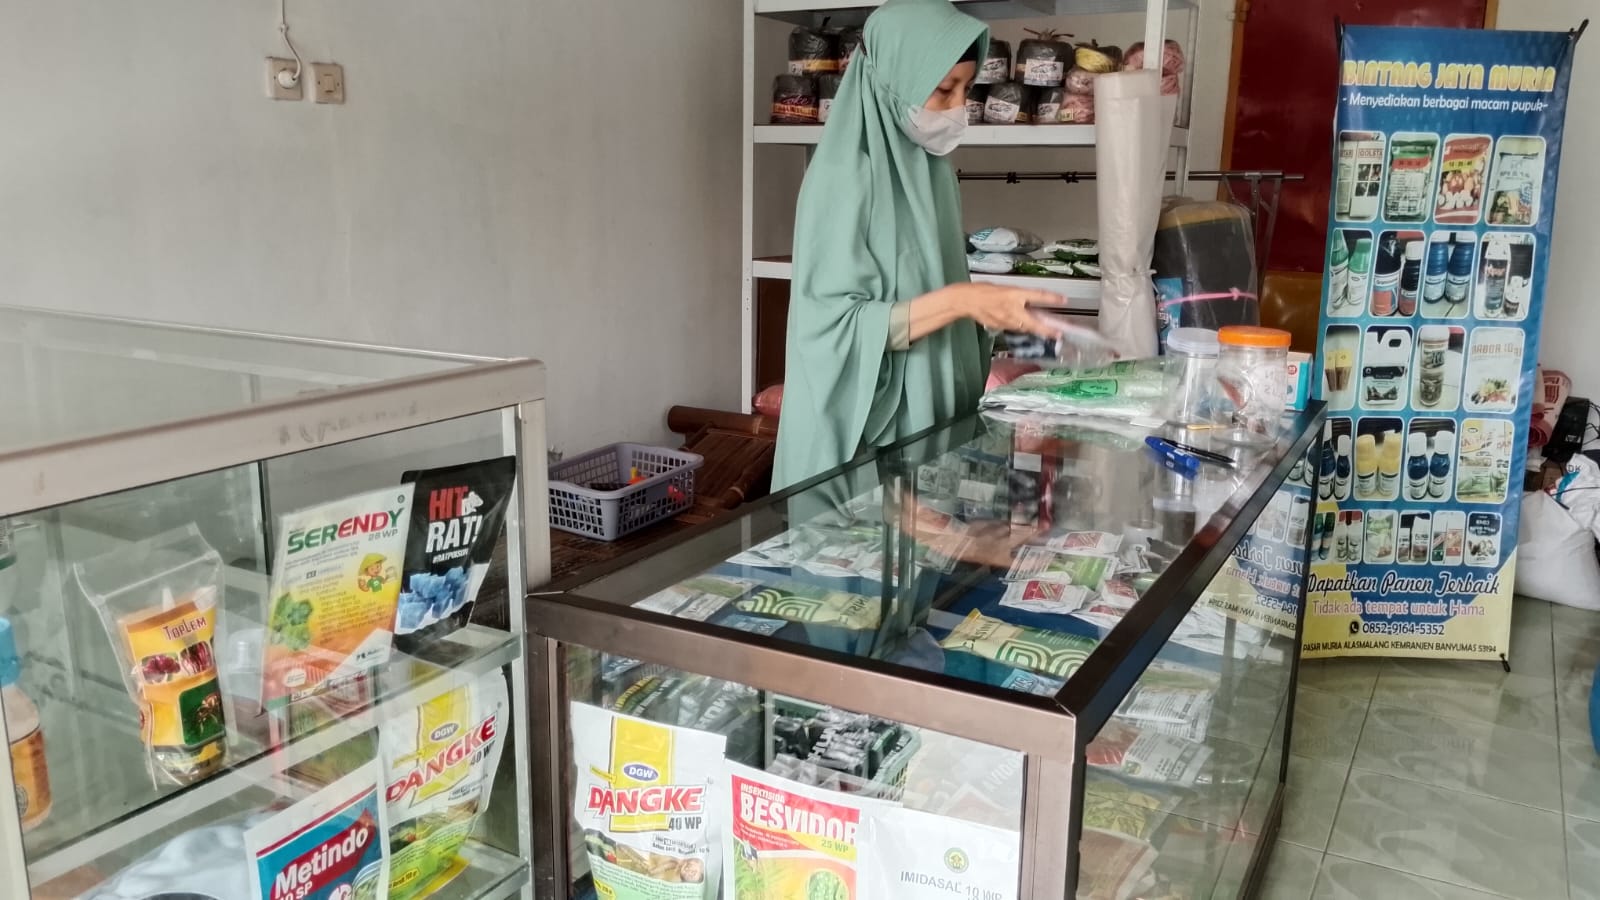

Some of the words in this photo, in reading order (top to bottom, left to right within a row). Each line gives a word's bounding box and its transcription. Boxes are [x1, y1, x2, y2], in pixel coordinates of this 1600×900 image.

[1342, 60, 1432, 88] BINTANG
[1435, 63, 1484, 89] JAYA
[1488, 65, 1556, 92] MURIA
[1422, 94, 1469, 110] berbagai
[1471, 99, 1509, 110] macam
[429, 486, 469, 522] HIT
[287, 507, 405, 555] SERENDY
[382, 529, 399, 539] WP
[425, 515, 483, 553] RAT!
[1307, 571, 1378, 597] Dapatkan
[1380, 570, 1433, 596] Panen
[1435, 571, 1499, 597] Terbaik
[1313, 600, 1340, 615] Tidak
[1343, 598, 1363, 614] ada
[1365, 601, 1409, 618] tempat
[1411, 600, 1447, 615] untuk
[1450, 599, 1485, 616] Hama
[1303, 643, 1321, 651] PASAR
[1322, 642, 1342, 650] MURIA
[1344, 641, 1389, 650] ALASMALANG
[1391, 641, 1434, 651] KEMRANJEN
[1435, 643, 1477, 652] BANYUMAS
[434, 725, 456, 739] DGW
[385, 714, 496, 804] DANGKE
[628, 766, 654, 779] DGW
[586, 785, 704, 817] DANGKE
[740, 782, 786, 804] INSEKTISIDA
[668, 817, 682, 831] 40
[684, 816, 702, 830] WP
[740, 791, 858, 846] BESVIDOR
[821, 839, 833, 849] 25
[834, 842, 849, 853] WP
[275, 827, 369, 900] Metindo
[295, 880, 313, 900] SP
[900, 870, 962, 894] IMIDASAL
[965, 883, 980, 898] 10
